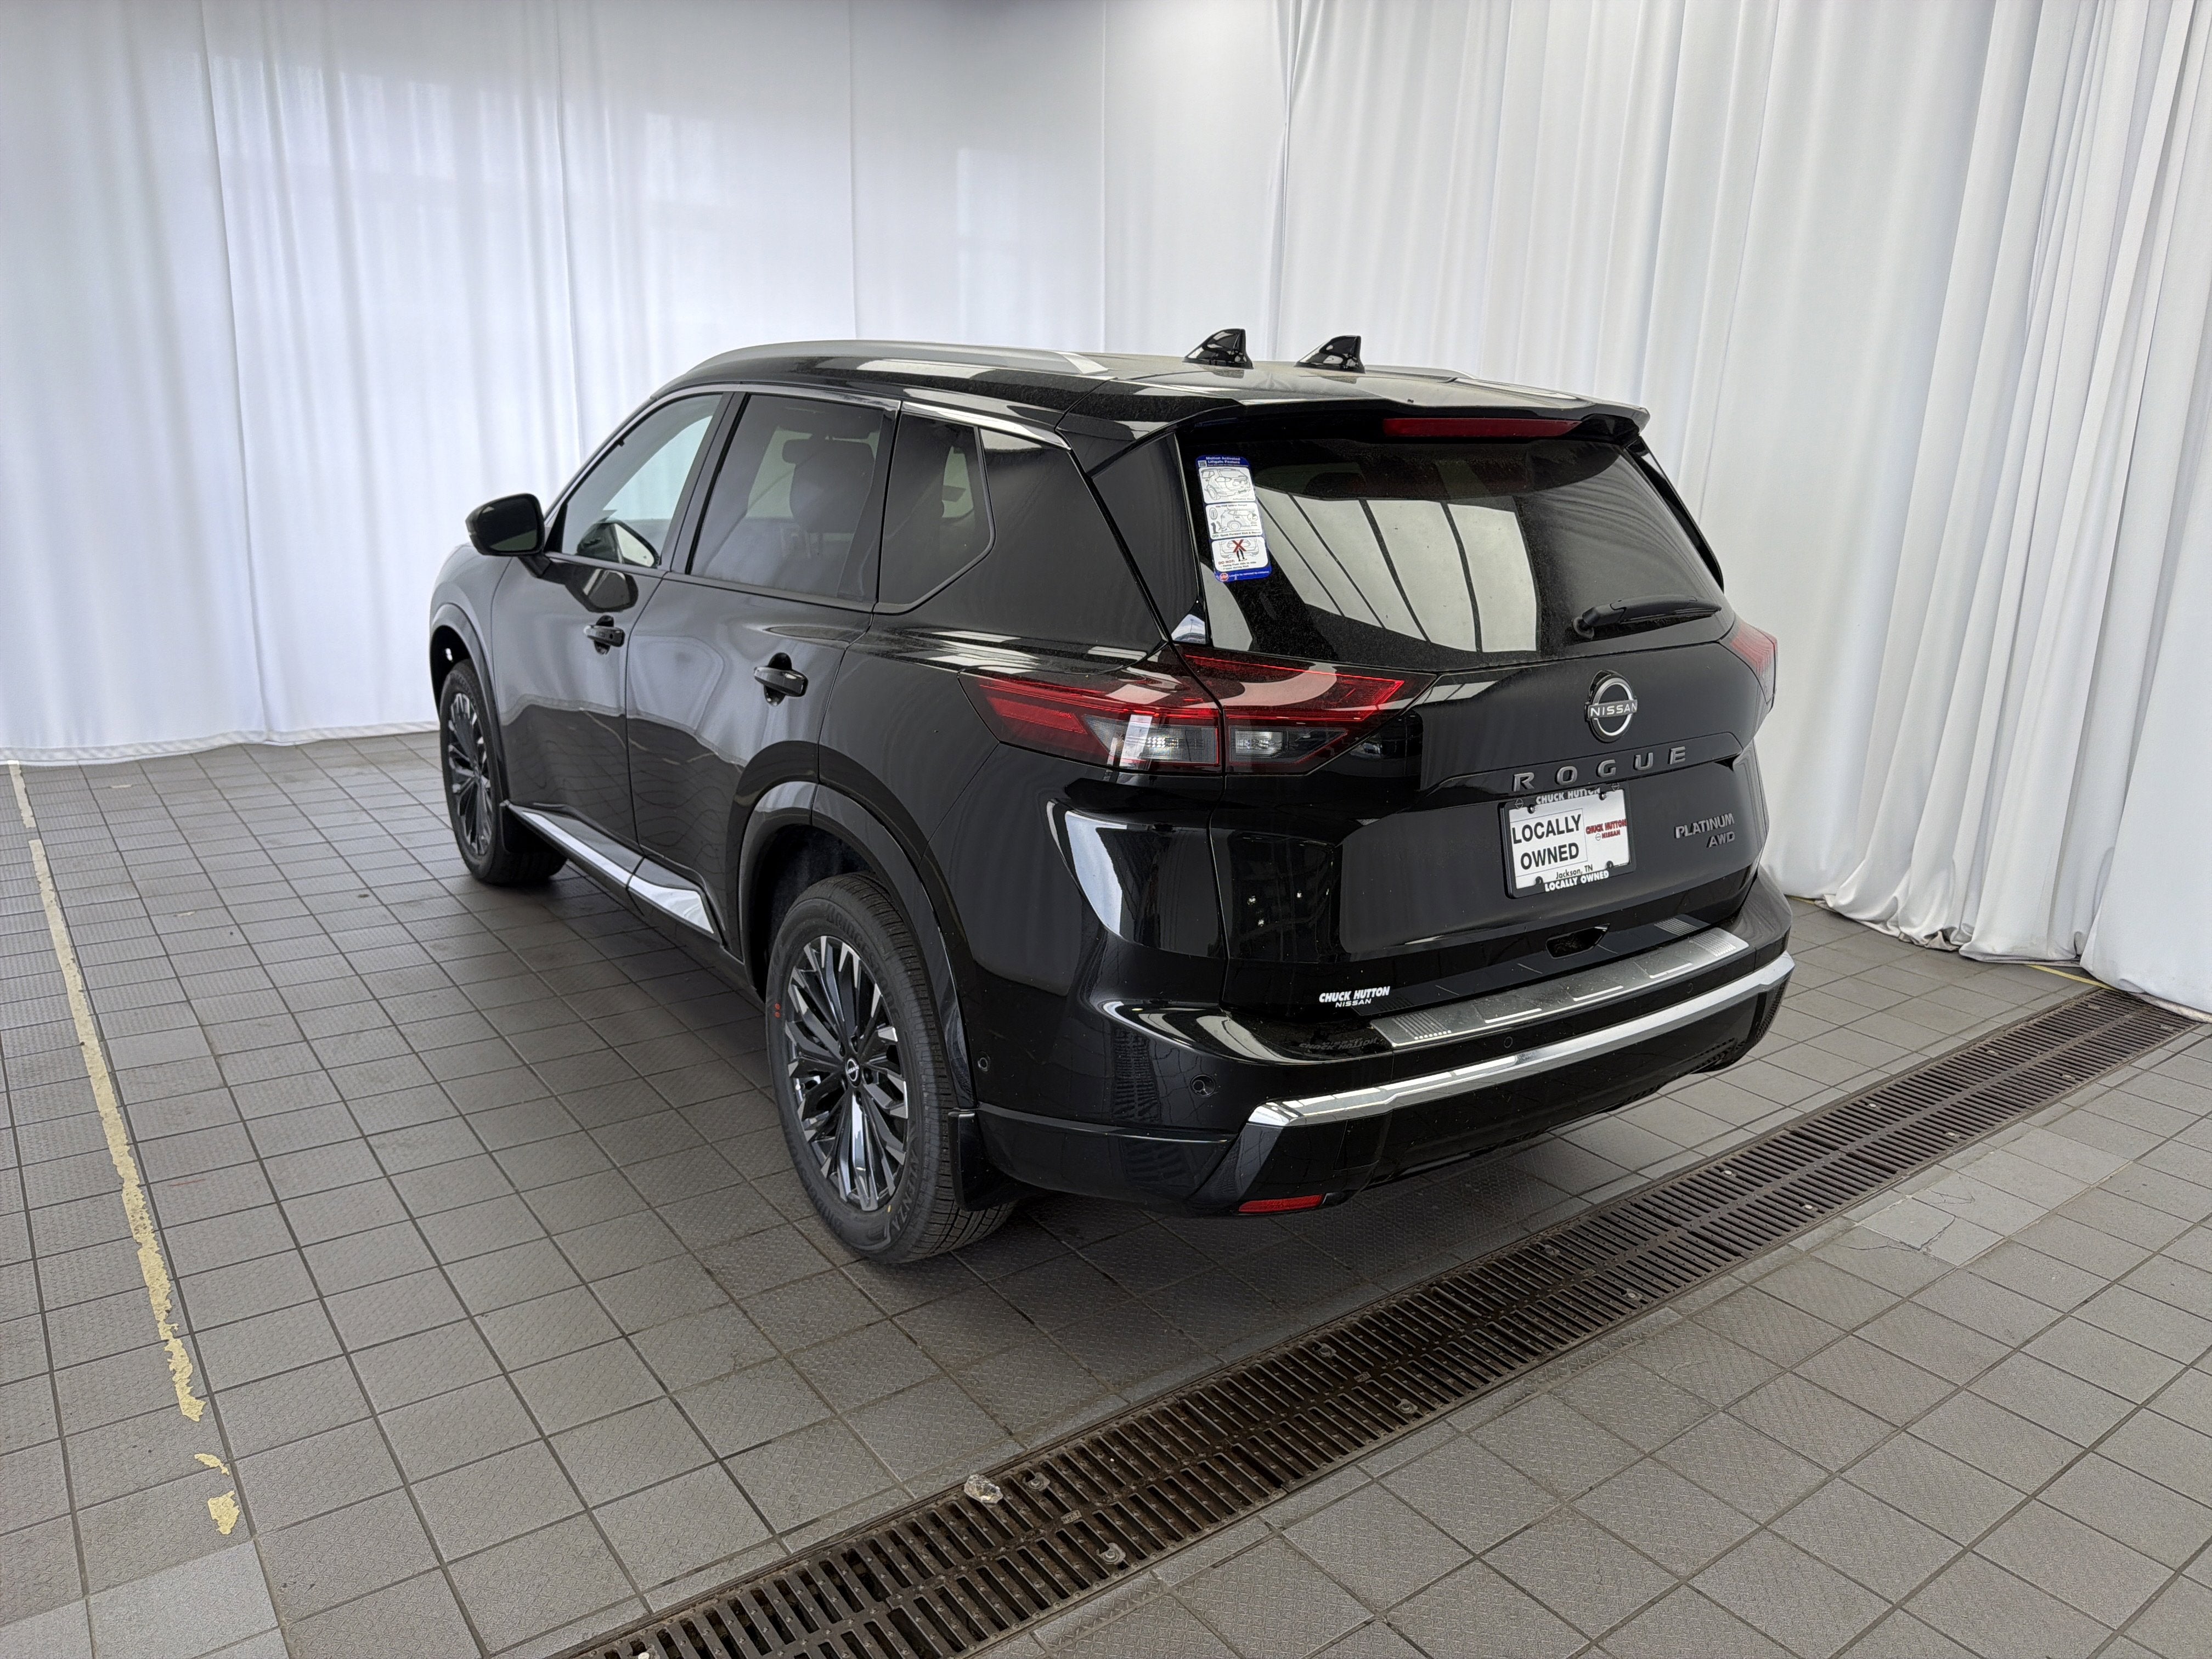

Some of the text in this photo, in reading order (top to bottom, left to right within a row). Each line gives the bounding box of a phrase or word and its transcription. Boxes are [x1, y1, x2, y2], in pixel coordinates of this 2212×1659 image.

[1590, 702, 1637, 716] NISSAN
[1513, 746, 1686, 792] ROGUE
[1536, 792, 1565, 804] CHUCK
[1512, 814, 1581, 844] LOCALLY
[1585, 819, 1627, 834] CHUCK HUTTON
[1674, 812, 1735, 839] PLATINUM
[1602, 830, 1621, 839] NISSAN
[1706, 831, 1735, 848] AWD
[1520, 842, 1579, 870] OWNED
[1544, 870, 1609, 892] LOCALLY OWNED
[1556, 868, 1583, 879] Jackson,
[1319, 986, 1391, 1003] CHUCK HUTTON
[1335, 998, 1372, 1008] NISSAN
